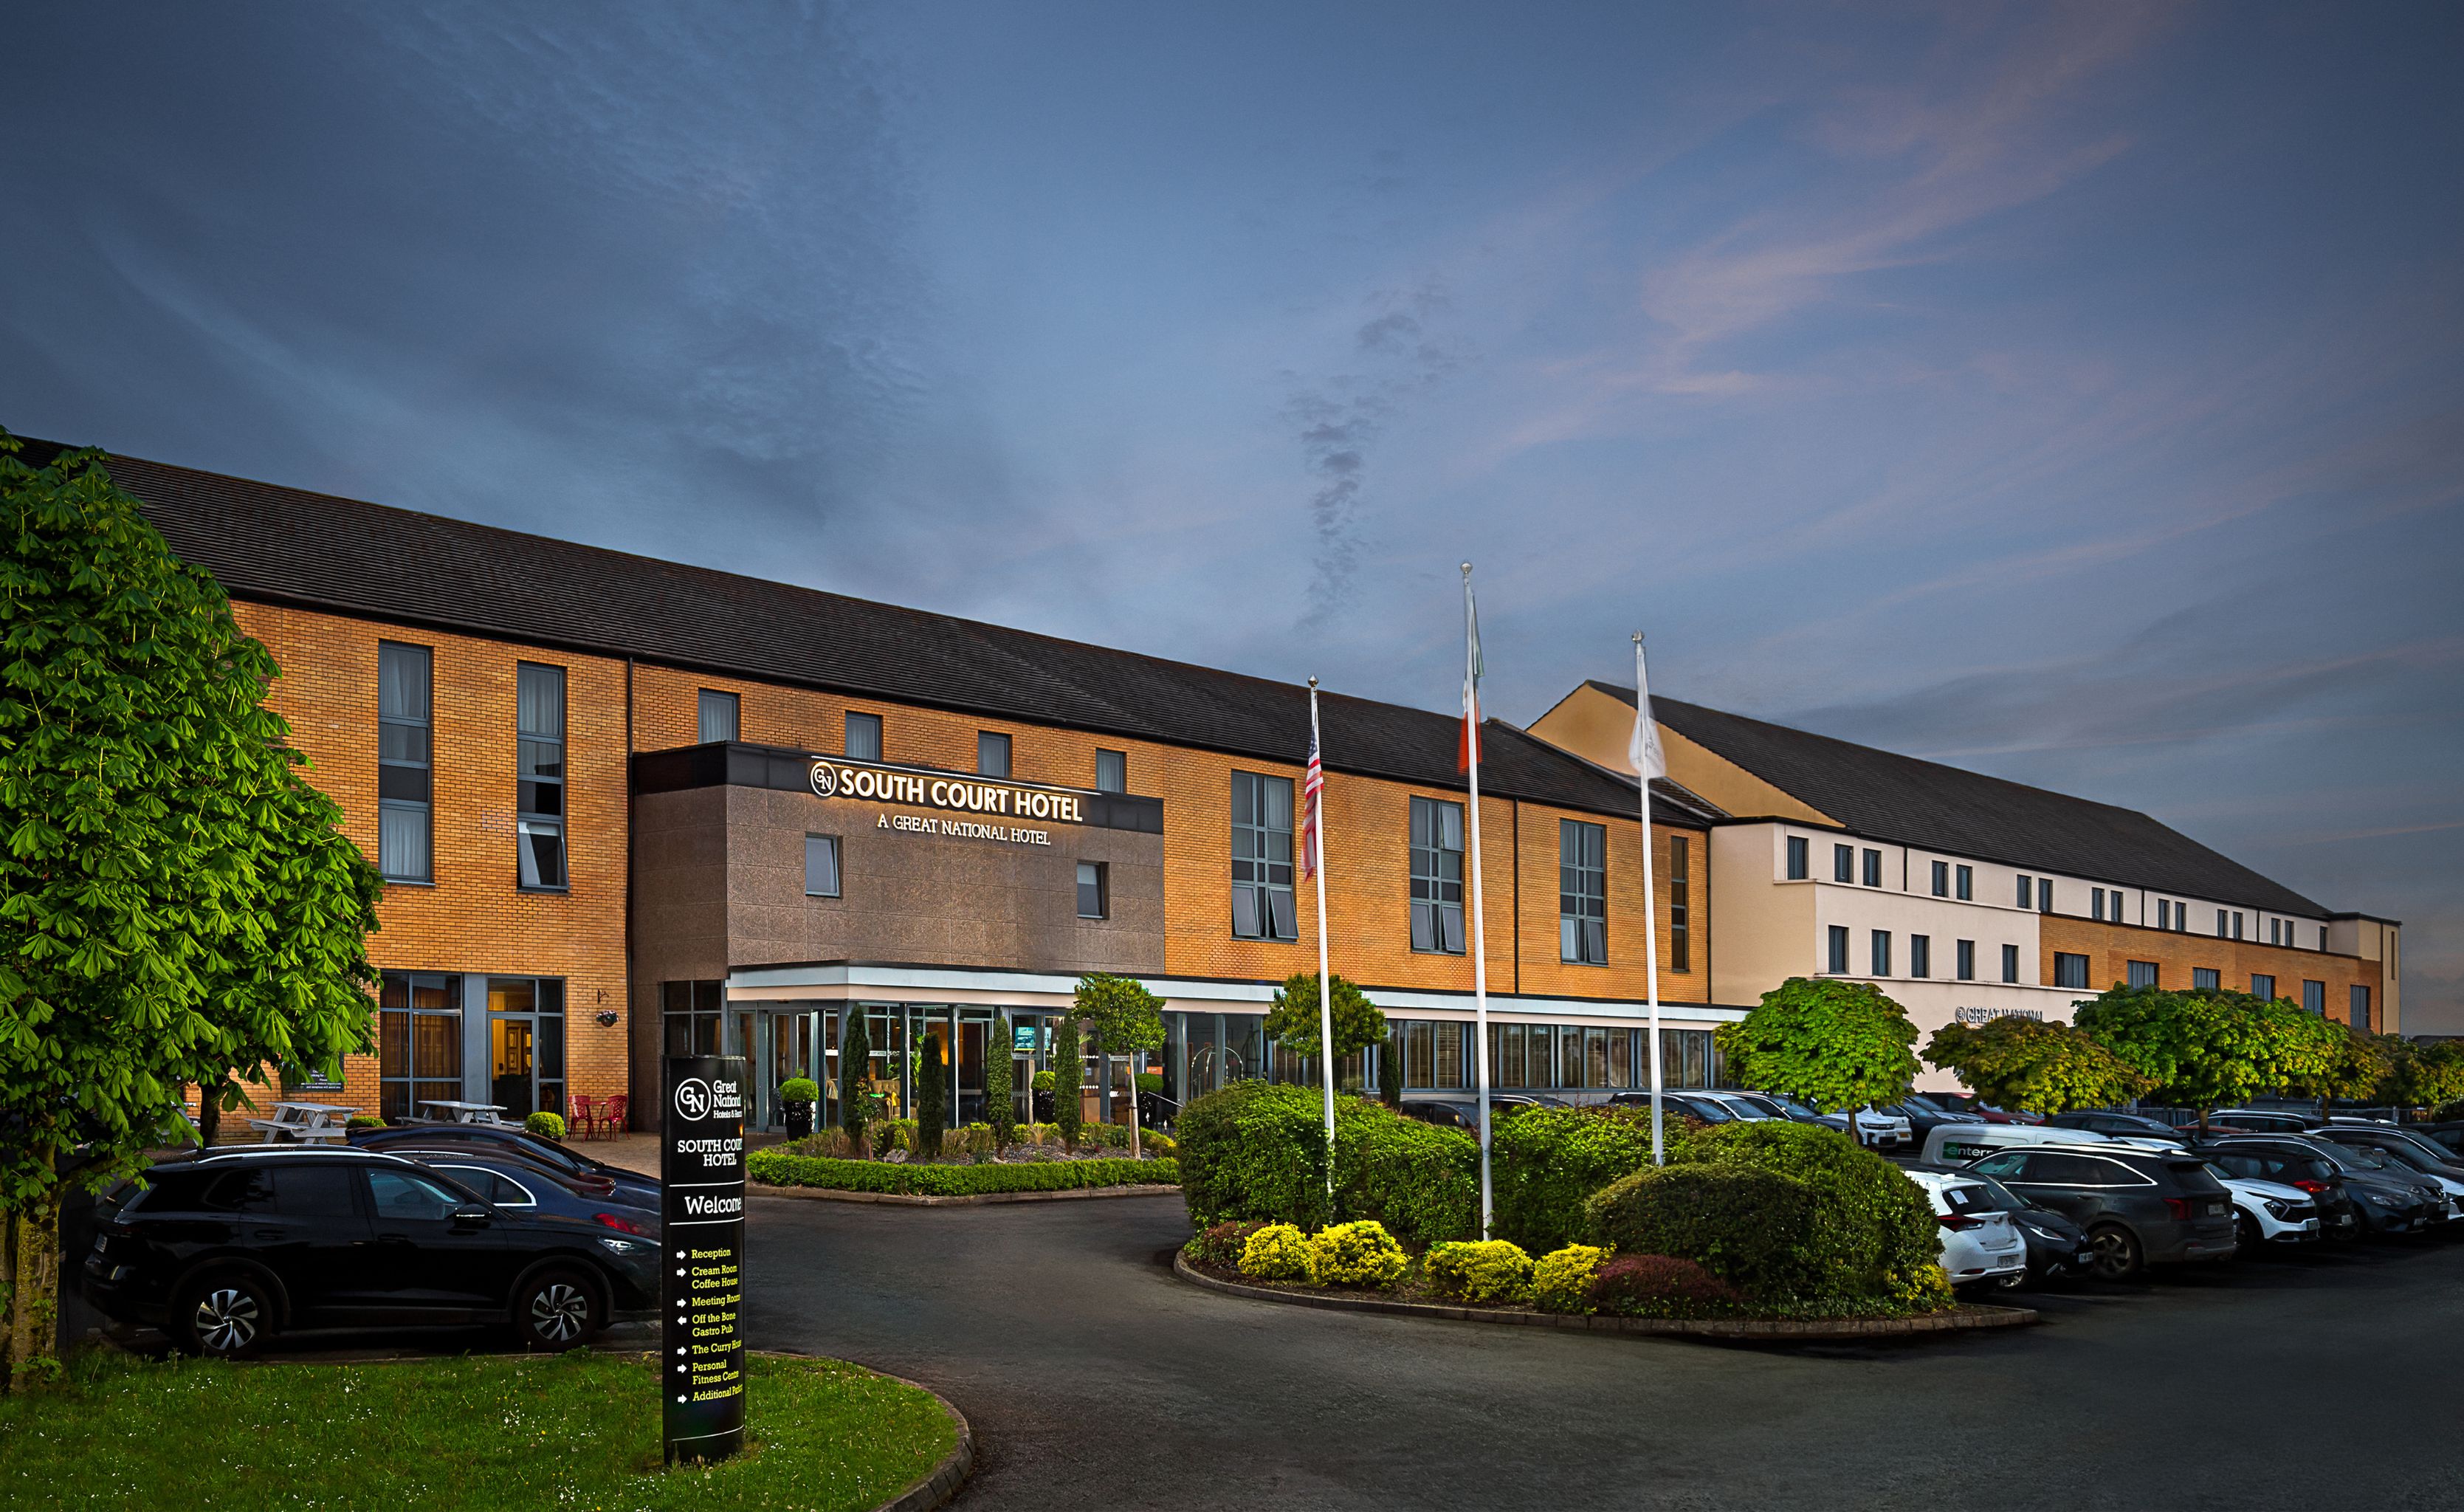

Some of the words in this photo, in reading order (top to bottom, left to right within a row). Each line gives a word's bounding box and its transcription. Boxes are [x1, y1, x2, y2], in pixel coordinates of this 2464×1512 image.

[839, 768, 925, 804] SOUTH
[930, 780, 1010, 814] COURT
[1015, 791, 1084, 822] HOTEL
[877, 814, 889, 828] A
[892, 817, 938, 834] GREAT
[941, 820, 1008, 841] NATIONAL
[1011, 828, 1051, 846] HOTEL
[1966, 1006, 1999, 1023] GREAT
[713, 1079, 737, 1093] Great
[678, 1139, 721, 1152] SOUTH
[703, 1153, 737, 1166] HOTEL
[684, 1195, 742, 1215] Welcome
[692, 1248, 731, 1260] Reception
[692, 1267, 720, 1276] Cream
[721, 1265, 737, 1274] Room
[692, 1279, 720, 1289] Coffee
[721, 1277, 738, 1287] House
[692, 1296, 726, 1307] Meeting
[692, 1314, 706, 1324] Off
[707, 1313, 720, 1322] the
[721, 1311, 736, 1322] Bone
[692, 1327, 720, 1337] Gastro
[721, 1324, 733, 1334] Pub
[692, 1344, 709, 1355] The
[710, 1342, 732, 1353] Curry
[692, 1359, 727, 1372] Personal
[692, 1373, 722, 1385] Fitness
[692, 1387, 732, 1402] Additional
